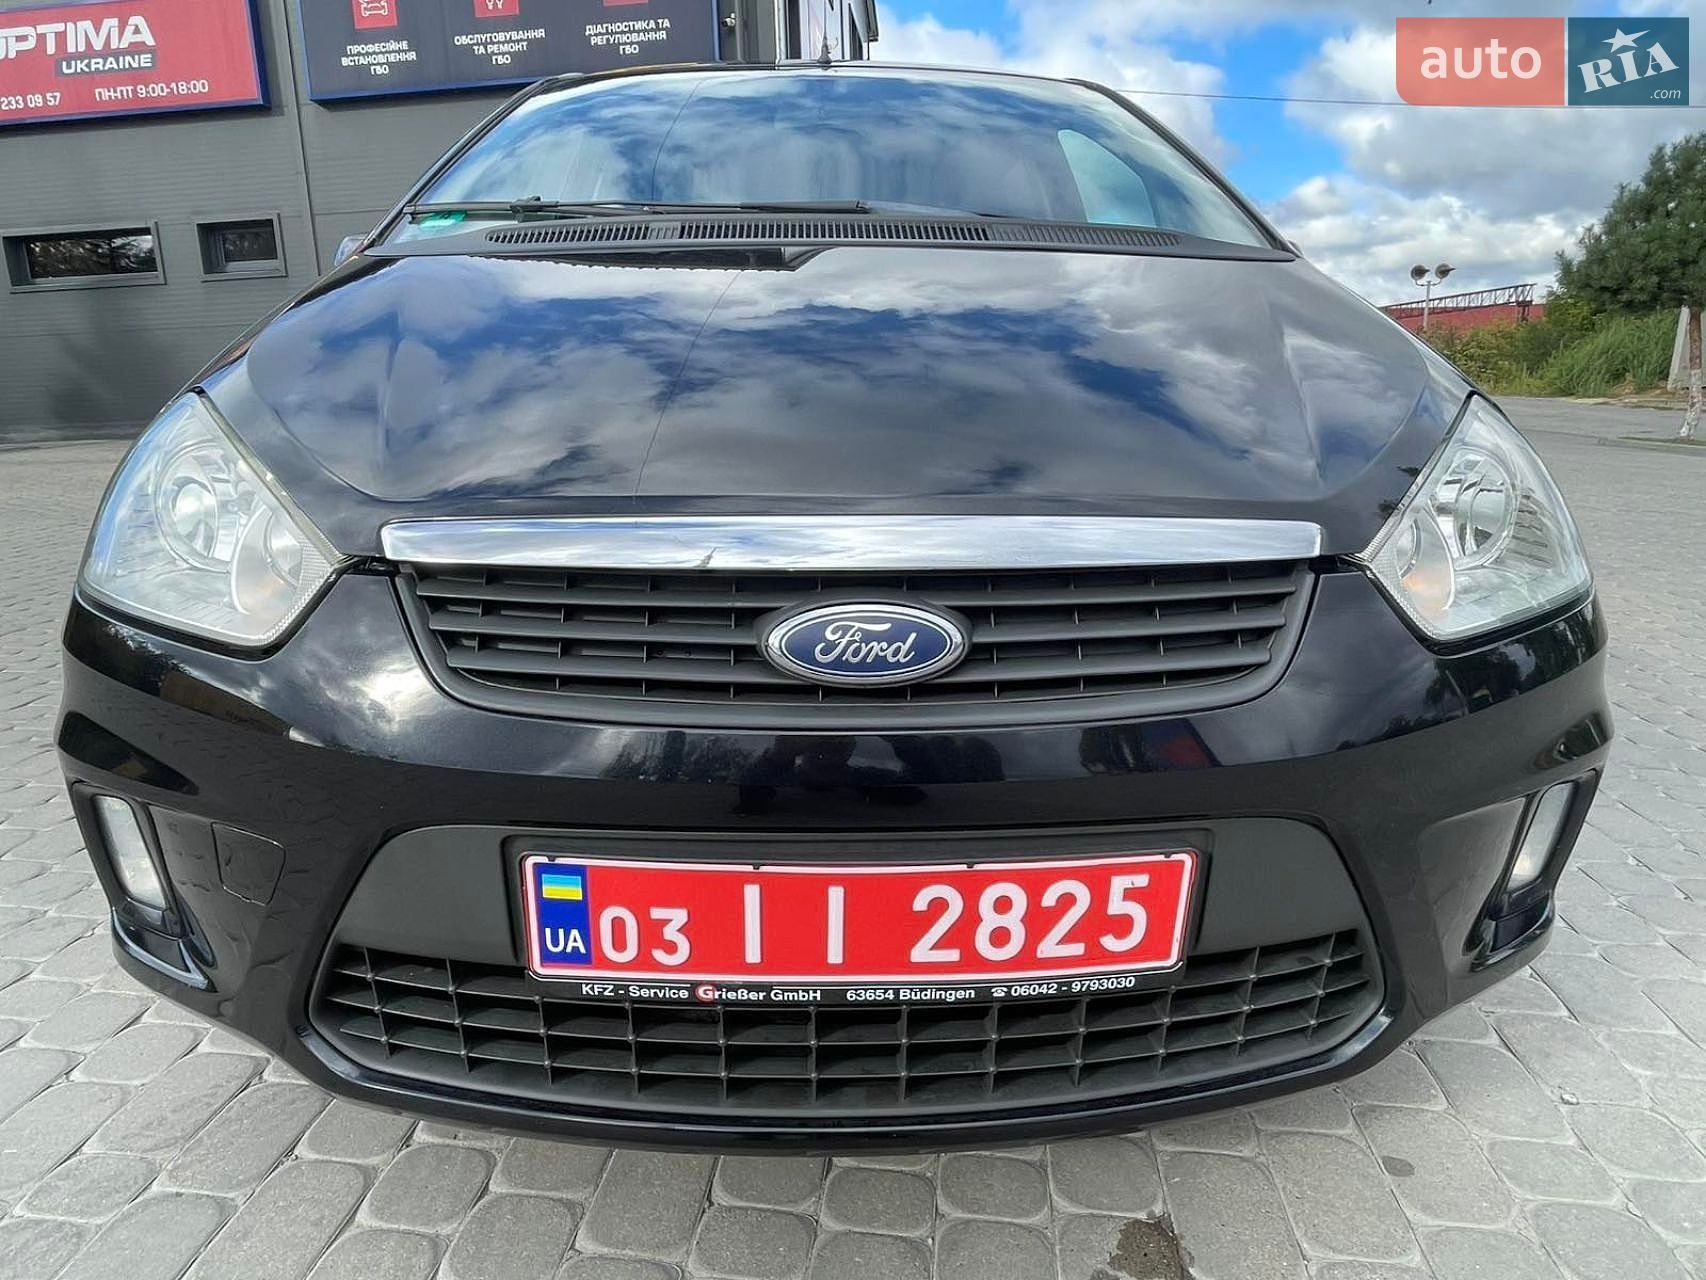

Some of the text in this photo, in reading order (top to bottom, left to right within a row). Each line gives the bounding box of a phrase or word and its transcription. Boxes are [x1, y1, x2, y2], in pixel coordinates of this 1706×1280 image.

[585, 18, 671, 36] ДІАГНОСТИКА ТА
[0, 15, 156, 60] PTIMA
[454, 28, 546, 46] ОБСЛУГОВУВАННЯ
[591, 30, 667, 46] РЕГУЛЮВАННЯ
[346, 39, 409, 55] ПРОФЕСІЙНЕ
[473, 41, 528, 55] ТА РЕМОНТ
[619, 44, 640, 55] ГБО
[62, 54, 153, 74] UKRAINE
[341, 51, 417, 67] ВСТАНОВЛЕННЯ
[492, 54, 511, 65] ГБО
[370, 64, 389, 75] ГБО
[45, 91, 61, 106] 57
[95, 79, 209, 101] ПН-ПТ 9:00-18:00
[814, 621, 917, 664] Ford
[599, 905, 692, 967] 03
[909, 873, 1150, 963] 2825
[544, 927, 587, 954] UA
[581, 983, 615, 997] KFZ
[628, 986, 690, 1000] Service
[697, 985, 767, 1002] Grießer
[770, 988, 822, 1002] GmbH
[846, 989, 895, 1002] 63654
[899, 987, 976, 1004] Büdingen
[1010, 982, 1059, 997] 06042
[1071, 975, 1137, 994] 9793030
